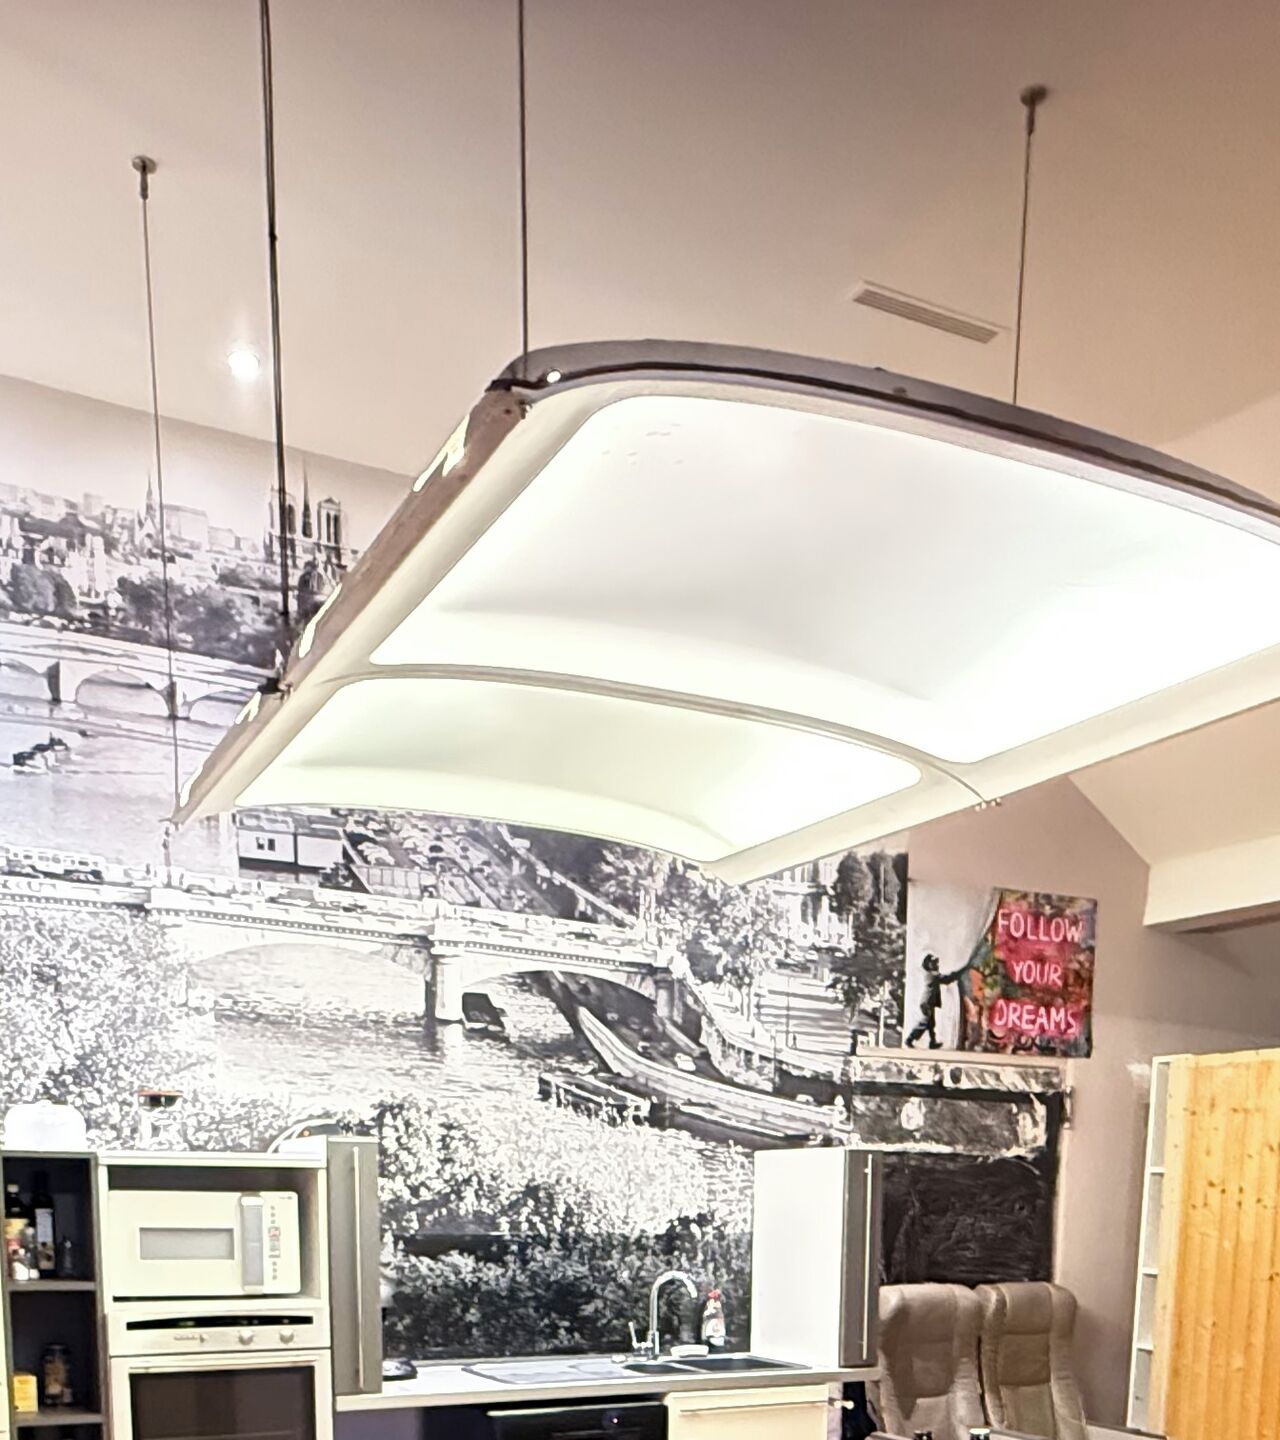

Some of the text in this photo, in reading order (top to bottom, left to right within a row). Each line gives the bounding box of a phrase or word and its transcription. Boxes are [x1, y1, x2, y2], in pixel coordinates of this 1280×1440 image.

[997, 908, 1083, 943] FOLLOW
[1011, 959, 1063, 986] YOUR
[993, 1000, 1078, 1034] DREAMS
